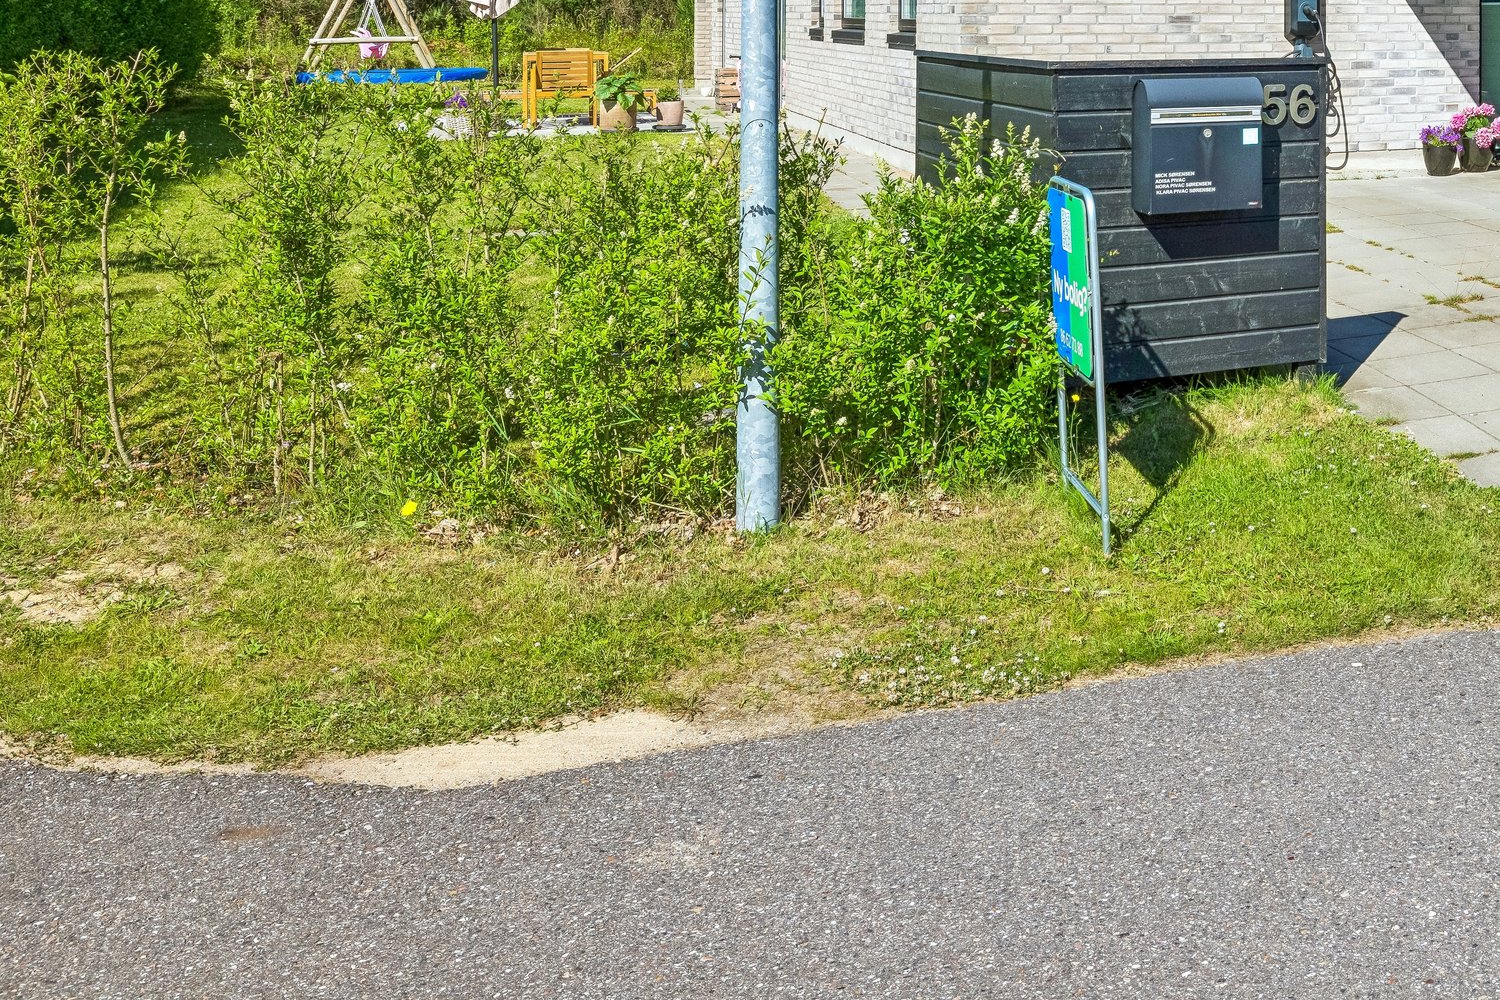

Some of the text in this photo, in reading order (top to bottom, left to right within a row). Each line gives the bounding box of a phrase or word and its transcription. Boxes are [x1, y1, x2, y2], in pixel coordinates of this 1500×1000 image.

[1261, 83, 1316, 126] 56
[1053, 268, 1087, 317] Ny bolig?
